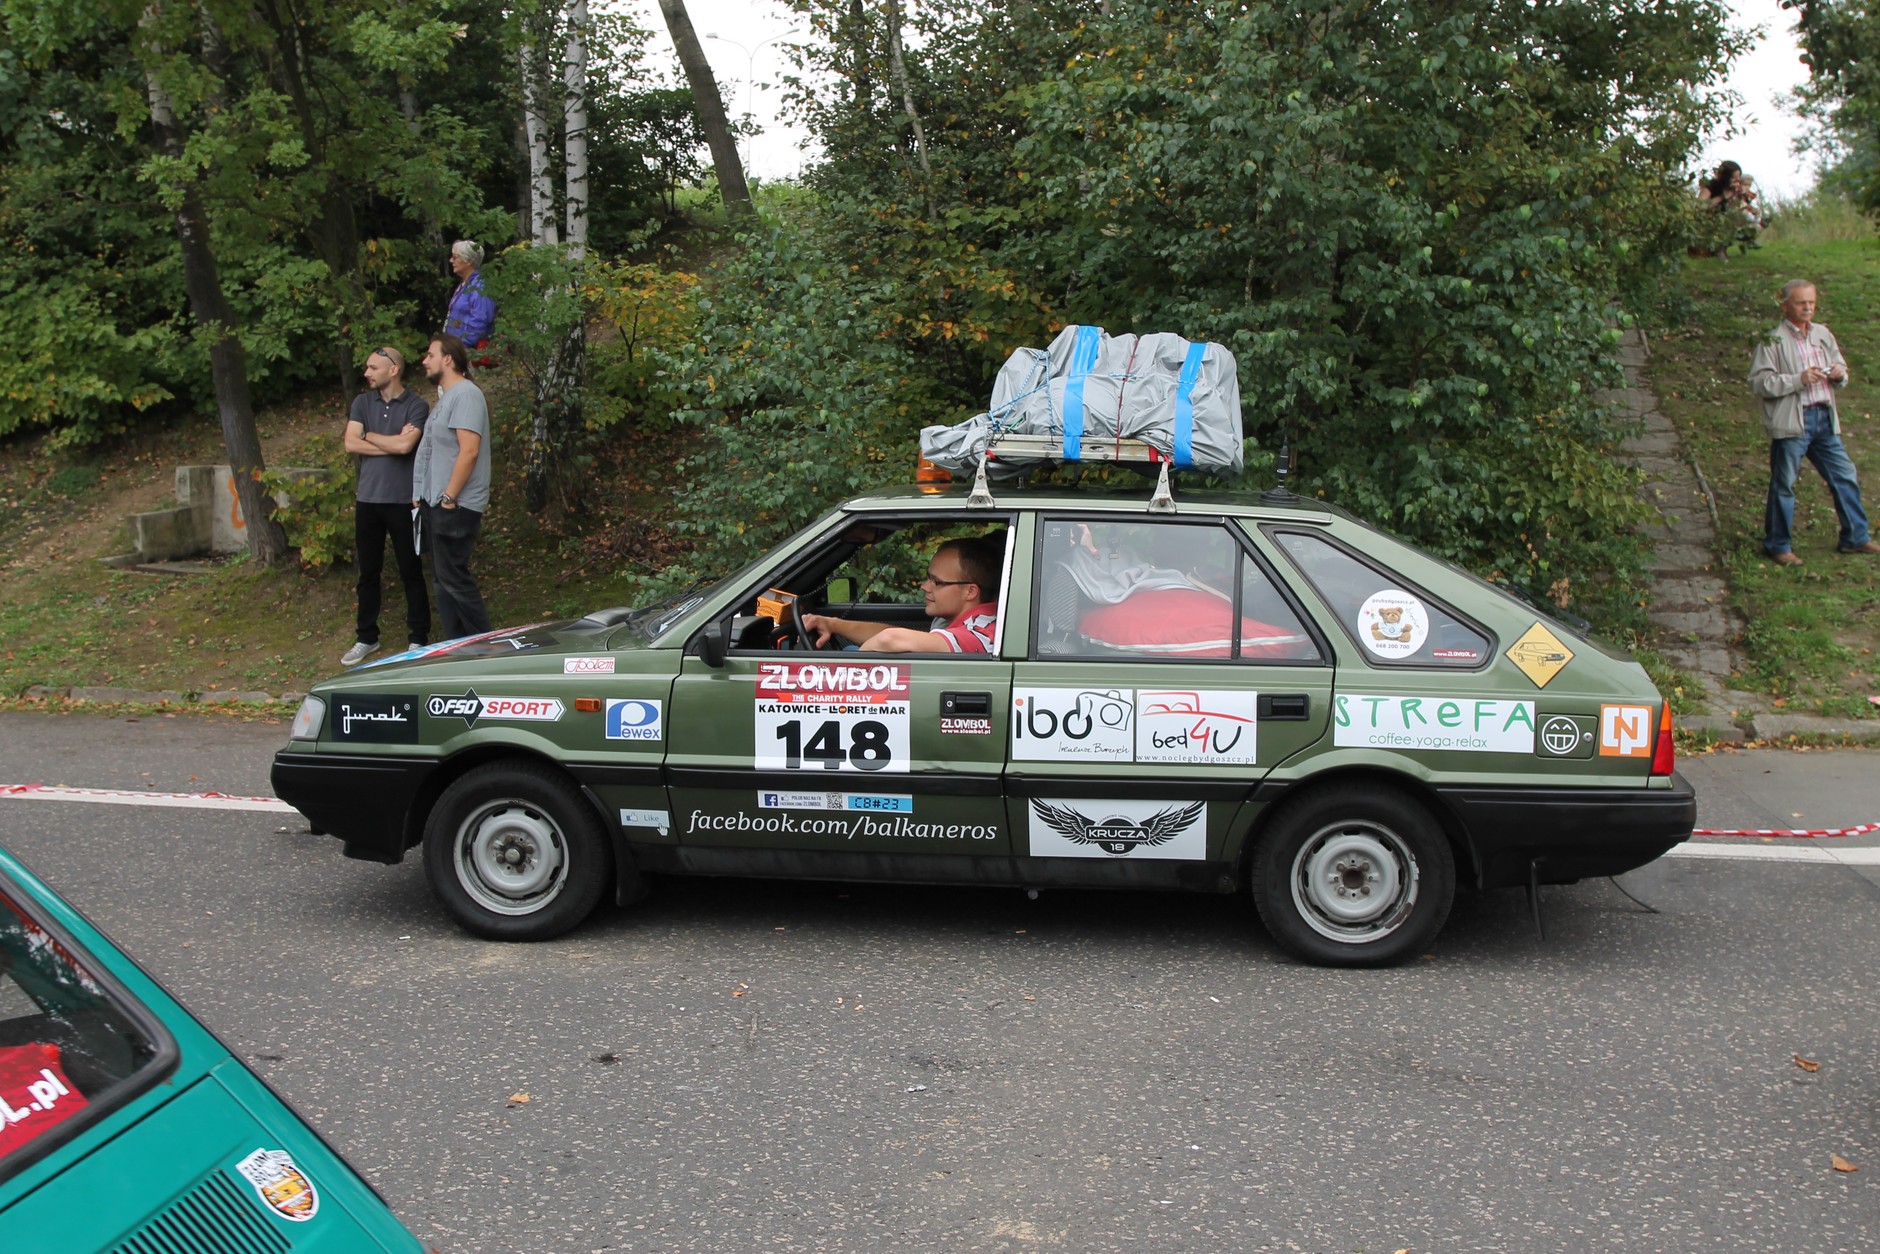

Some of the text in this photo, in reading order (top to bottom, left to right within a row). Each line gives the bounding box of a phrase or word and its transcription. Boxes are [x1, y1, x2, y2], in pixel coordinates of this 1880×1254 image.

[792, 694, 804, 702] THE
[846, 695, 872, 703] RALLY
[443, 699, 553, 716] FSO SPORT
[868, 706, 878, 715] de
[879, 706, 906, 715] MAR
[776, 719, 892, 771] 148
[1136, 754, 1254, 764] www.noclegbydgoszcz.pl
[643, 814, 659, 822] Like
[687, 809, 998, 840] facebook.com/balkaneros
[1088, 829, 1147, 838] KRUCZA
[1110, 843, 1125, 851] 18
